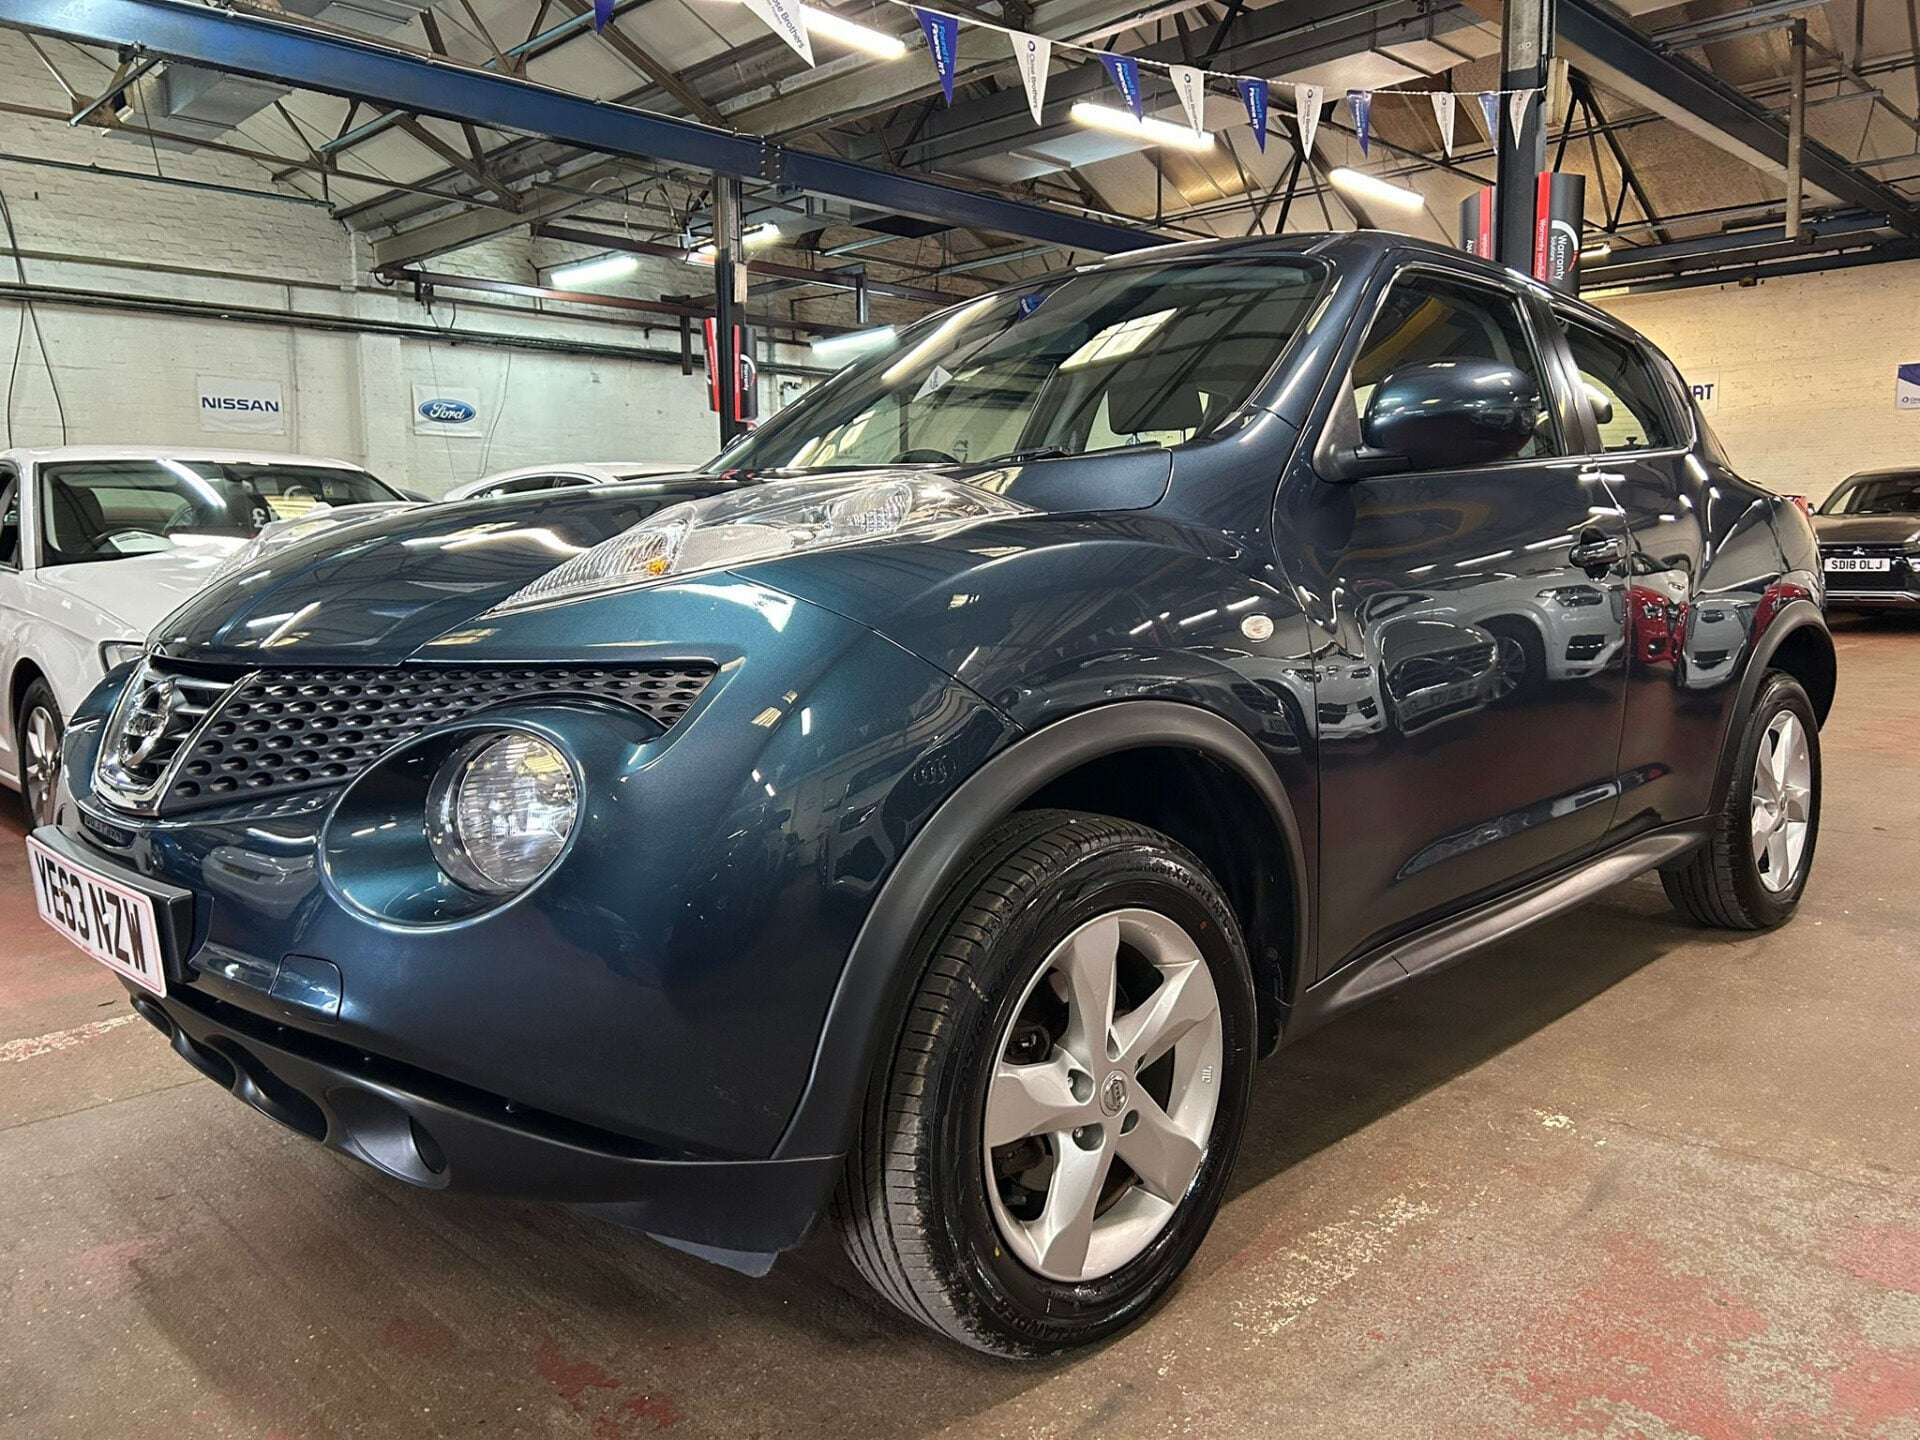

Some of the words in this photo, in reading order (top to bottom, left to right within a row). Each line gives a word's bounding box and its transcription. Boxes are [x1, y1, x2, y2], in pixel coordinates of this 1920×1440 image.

[780, 12, 805, 49] Brothers
[939, 25, 949, 57] Found
[931, 22, 942, 60] Finance
[937, 61, 946, 75] it?
[1555, 234, 1567, 280] Warranty
[201, 396, 280, 412] NISSAN
[1689, 383, 1714, 400] AT
[429, 401, 466, 420] Ford
[1831, 560, 1857, 570] SD18
[1859, 560, 1883, 570] OLJ
[34, 850, 90, 941] YE63
[88, 882, 147, 974] NZW
